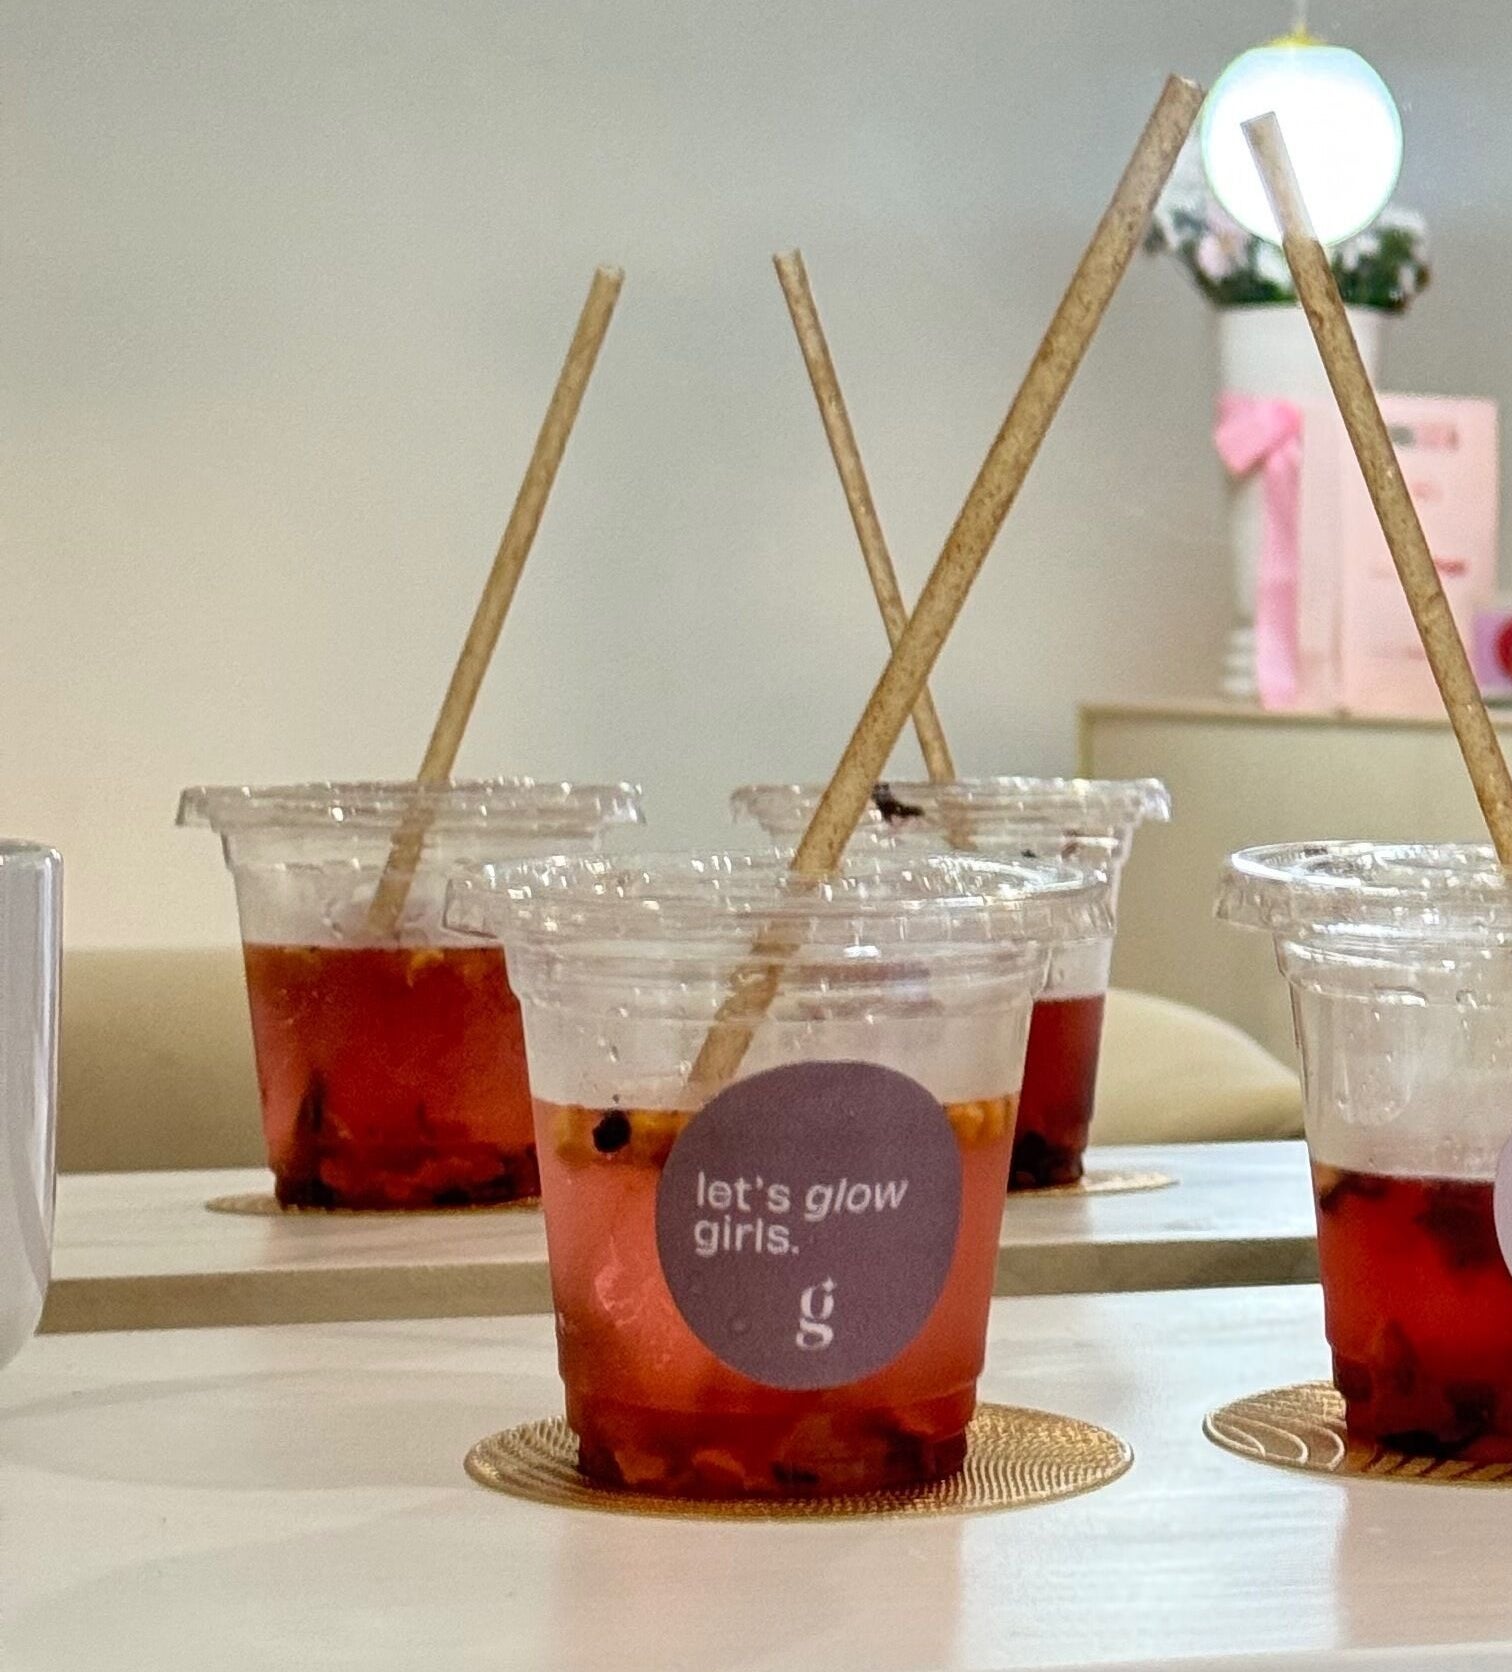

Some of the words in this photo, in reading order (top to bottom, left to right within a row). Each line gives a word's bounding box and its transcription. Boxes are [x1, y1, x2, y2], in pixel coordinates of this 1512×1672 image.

[697, 1171, 791, 1213] let's
[804, 1178, 908, 1221] glow
[694, 1215, 799, 1257] girls.
[796, 1277, 836, 1351] g
